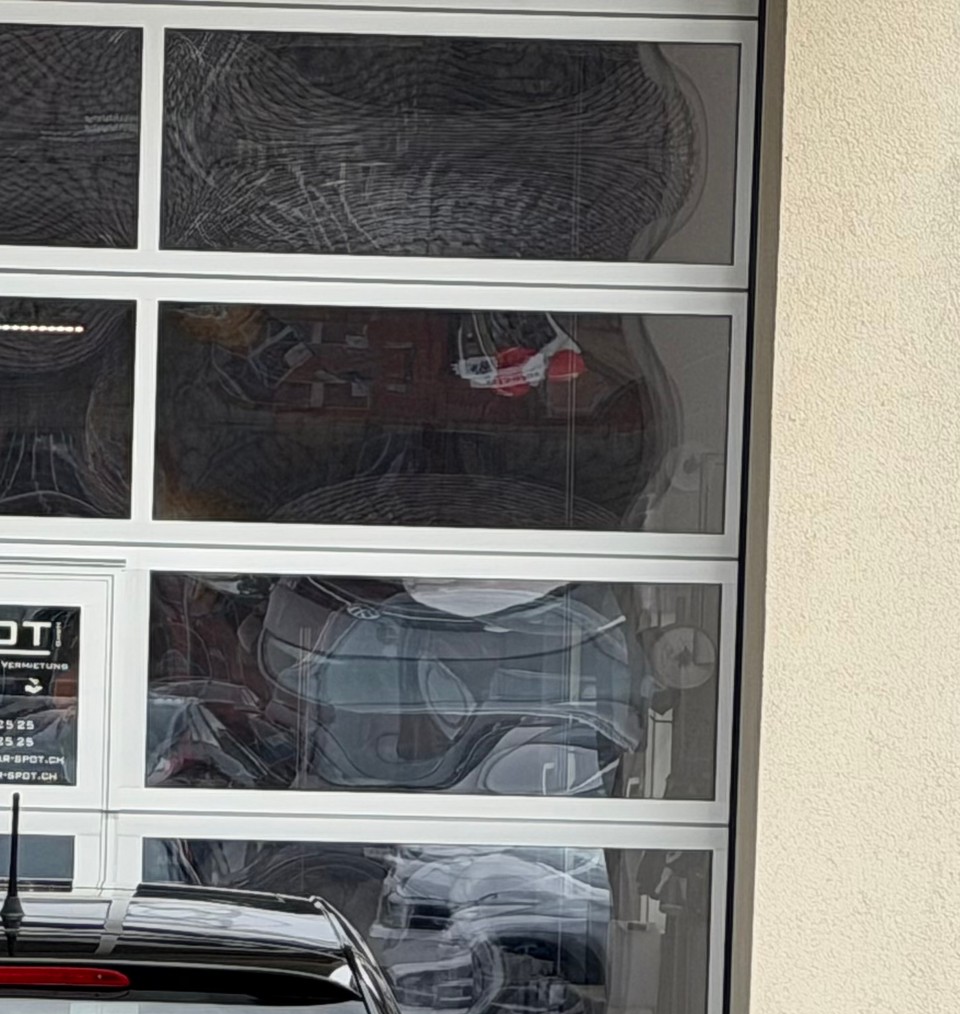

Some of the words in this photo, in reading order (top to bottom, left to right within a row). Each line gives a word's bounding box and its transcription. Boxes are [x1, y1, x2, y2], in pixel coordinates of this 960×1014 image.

[1, 660, 69, 671] VERMIETUNG
[17, 720, 35, 730] 25
[16, 737, 35, 747] 25
